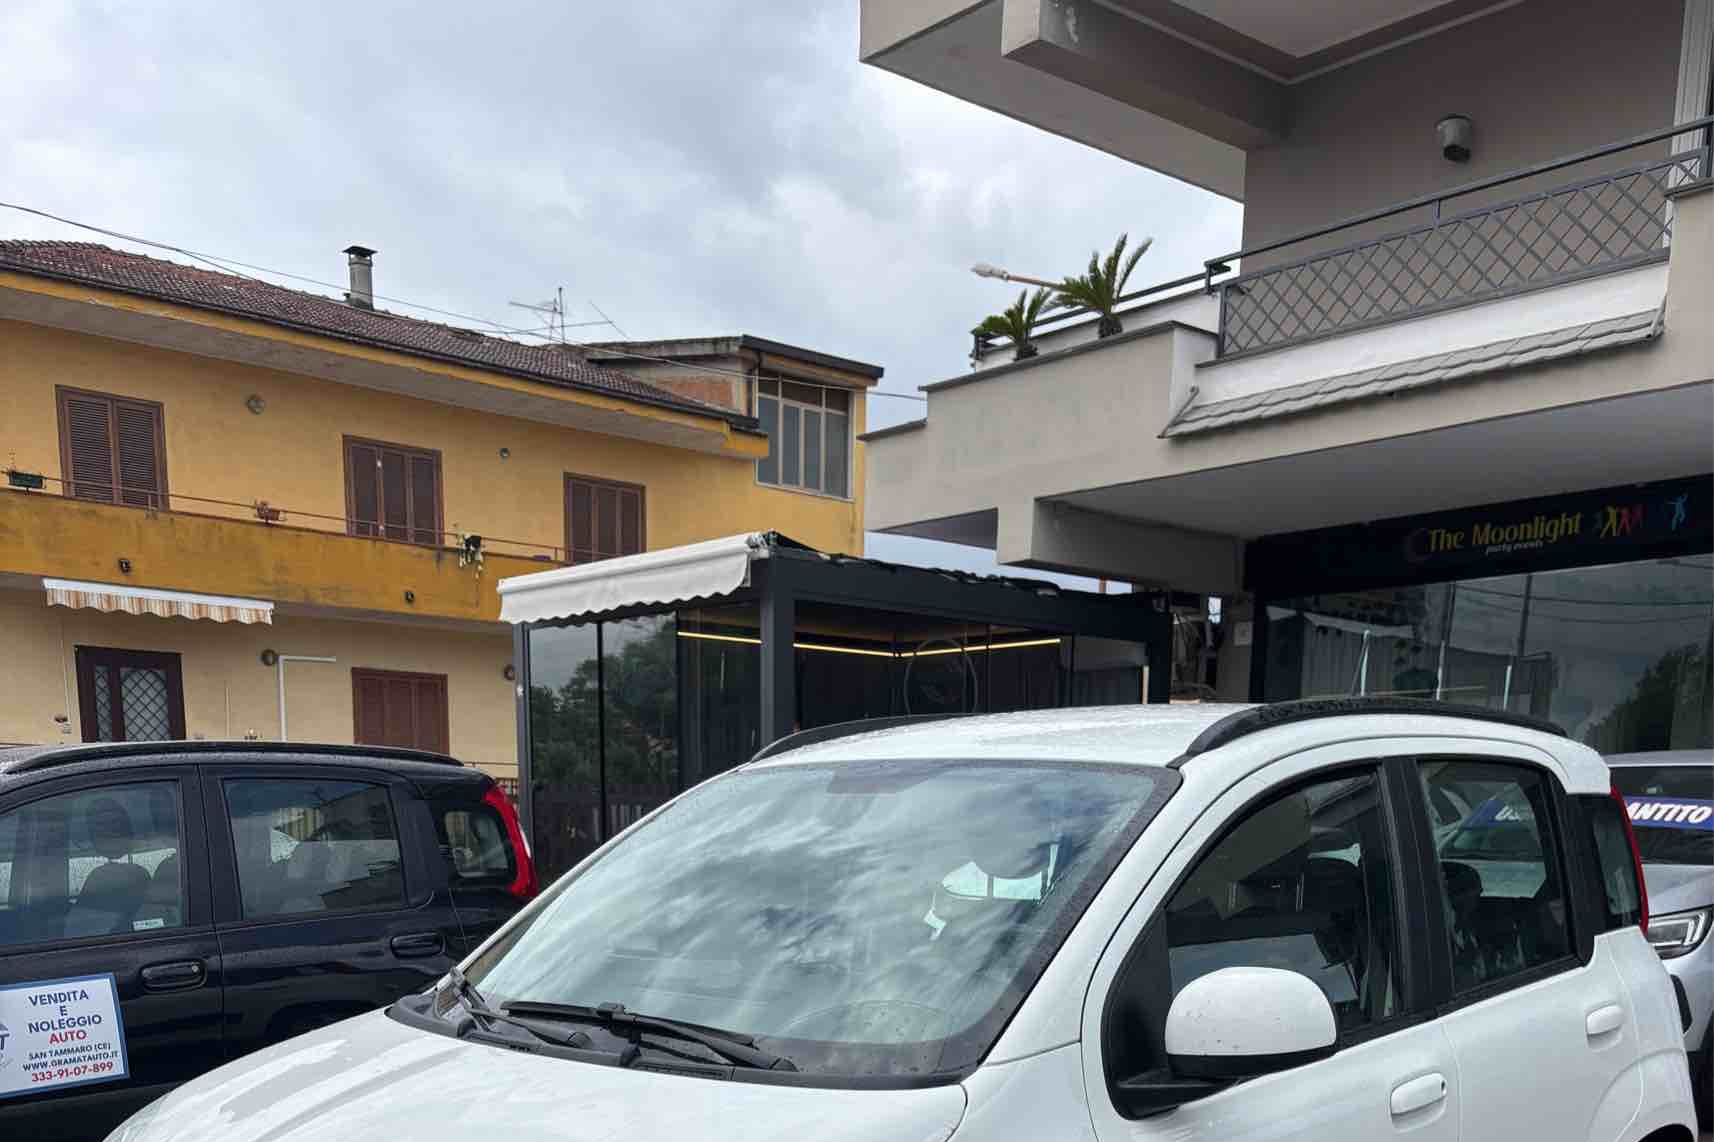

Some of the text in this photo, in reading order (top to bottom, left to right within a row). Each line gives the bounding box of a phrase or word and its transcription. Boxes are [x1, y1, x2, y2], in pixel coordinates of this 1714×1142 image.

[1429, 511, 1583, 552] The Moonlight
[28, 989, 89, 1006] VENDITA
[60, 1005, 68, 1017] E
[28, 1014, 102, 1034] NOLEGGIO
[49, 1029, 87, 1045] AUTO
[29, 1042, 111, 1061] SAN TAMMARO (CE)
[31, 1061, 113, 1082] 333-91-07-899
